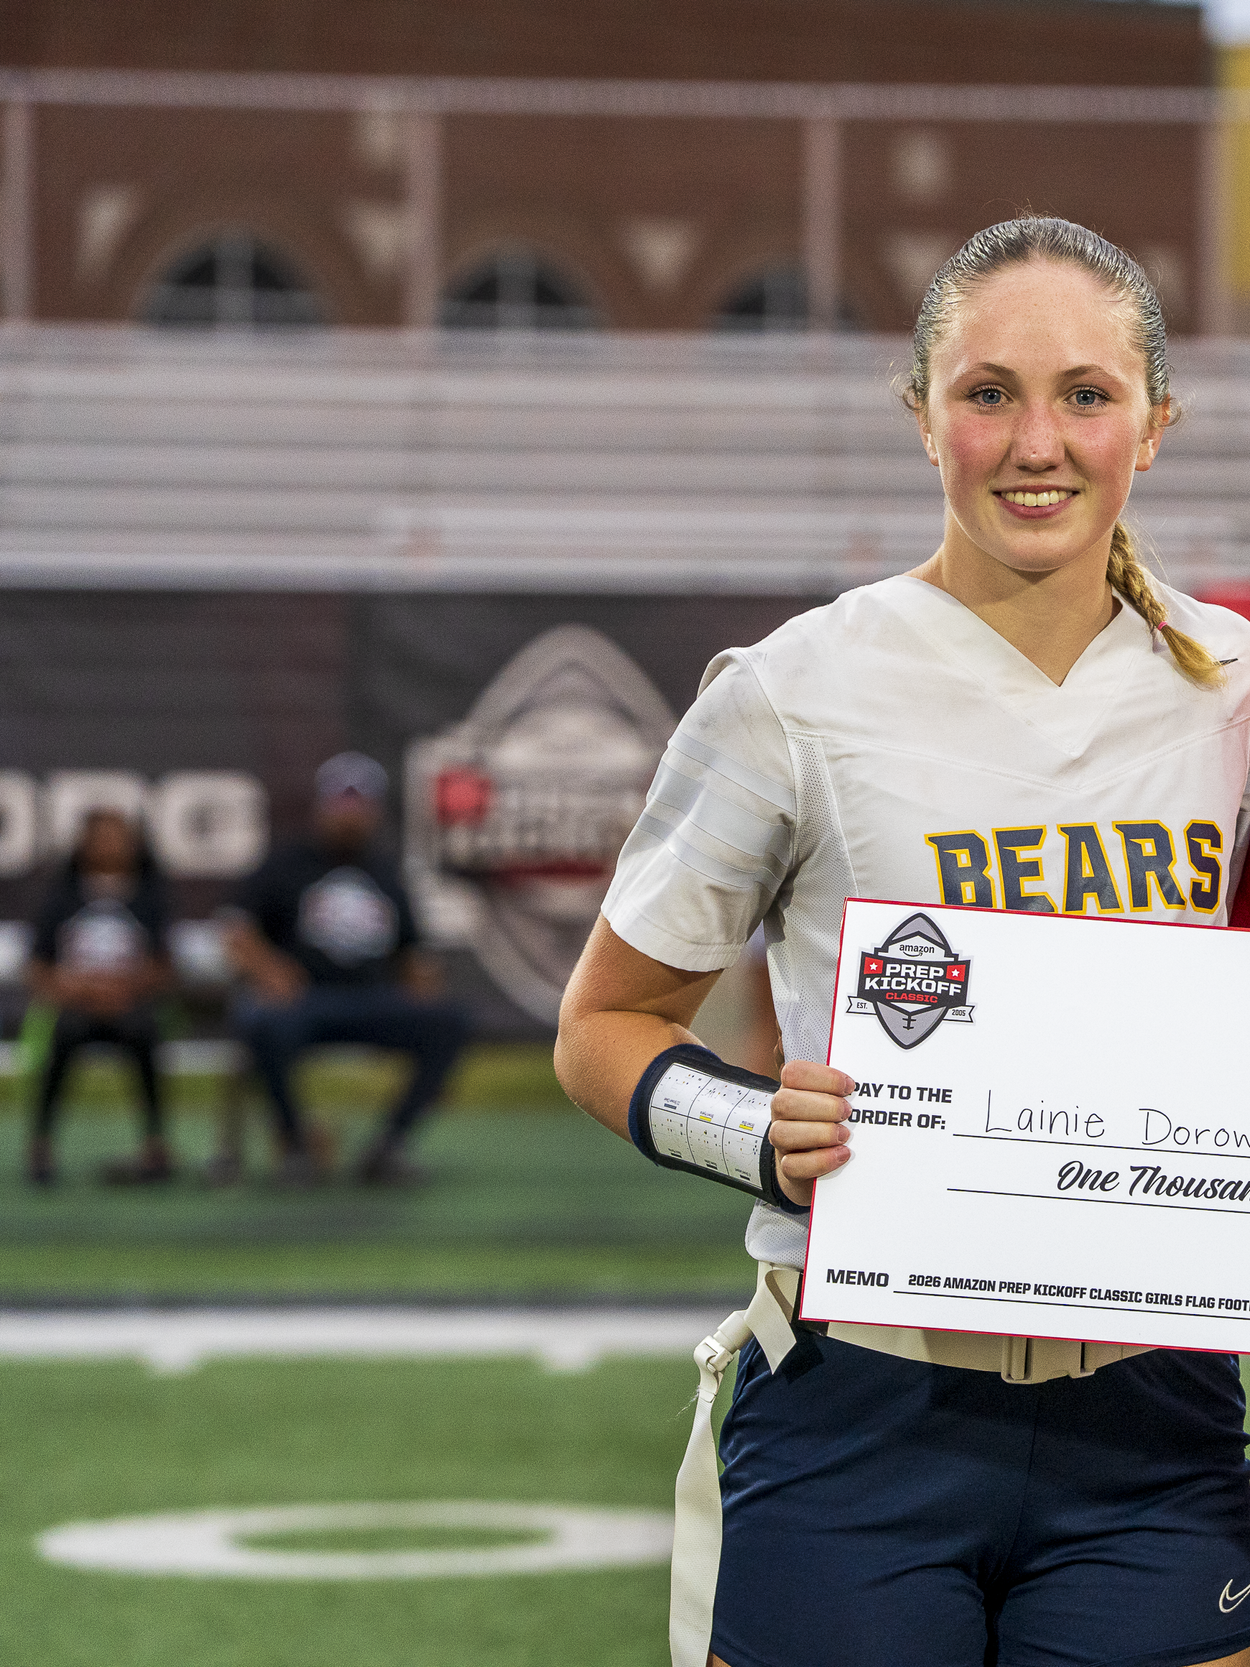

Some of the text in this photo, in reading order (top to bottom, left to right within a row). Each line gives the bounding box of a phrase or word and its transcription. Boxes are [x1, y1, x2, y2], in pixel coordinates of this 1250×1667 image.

[924, 819, 1224, 914] BEARS
[899, 944, 935, 954] amazon
[885, 963, 944, 979] PREP
[864, 977, 962, 996] KICKOFF
[856, 1002, 868, 1010] EST.
[885, 991, 938, 1003] CLASSIC
[951, 1009, 966, 1017] 2005
[887, 1084, 912, 1101] TO
[916, 1086, 953, 1104] THE
[848, 1108, 946, 1130] ORDER OF:
[985, 1089, 1105, 1138] Lainie
[1056, 1160, 1120, 1192] One
[826, 1268, 890, 1288] MEMO
[908, 1273, 942, 1288] 2026
[942, 1276, 997, 1292] AMAZON
[998, 1280, 1032, 1295] PREP
[1033, 1283, 1088, 1299] KICKOFF
[1089, 1288, 1143, 1304] CLASSIC
[1144, 1292, 1184, 1307] GIRLS
[1185, 1295, 1216, 1309] FLAG
